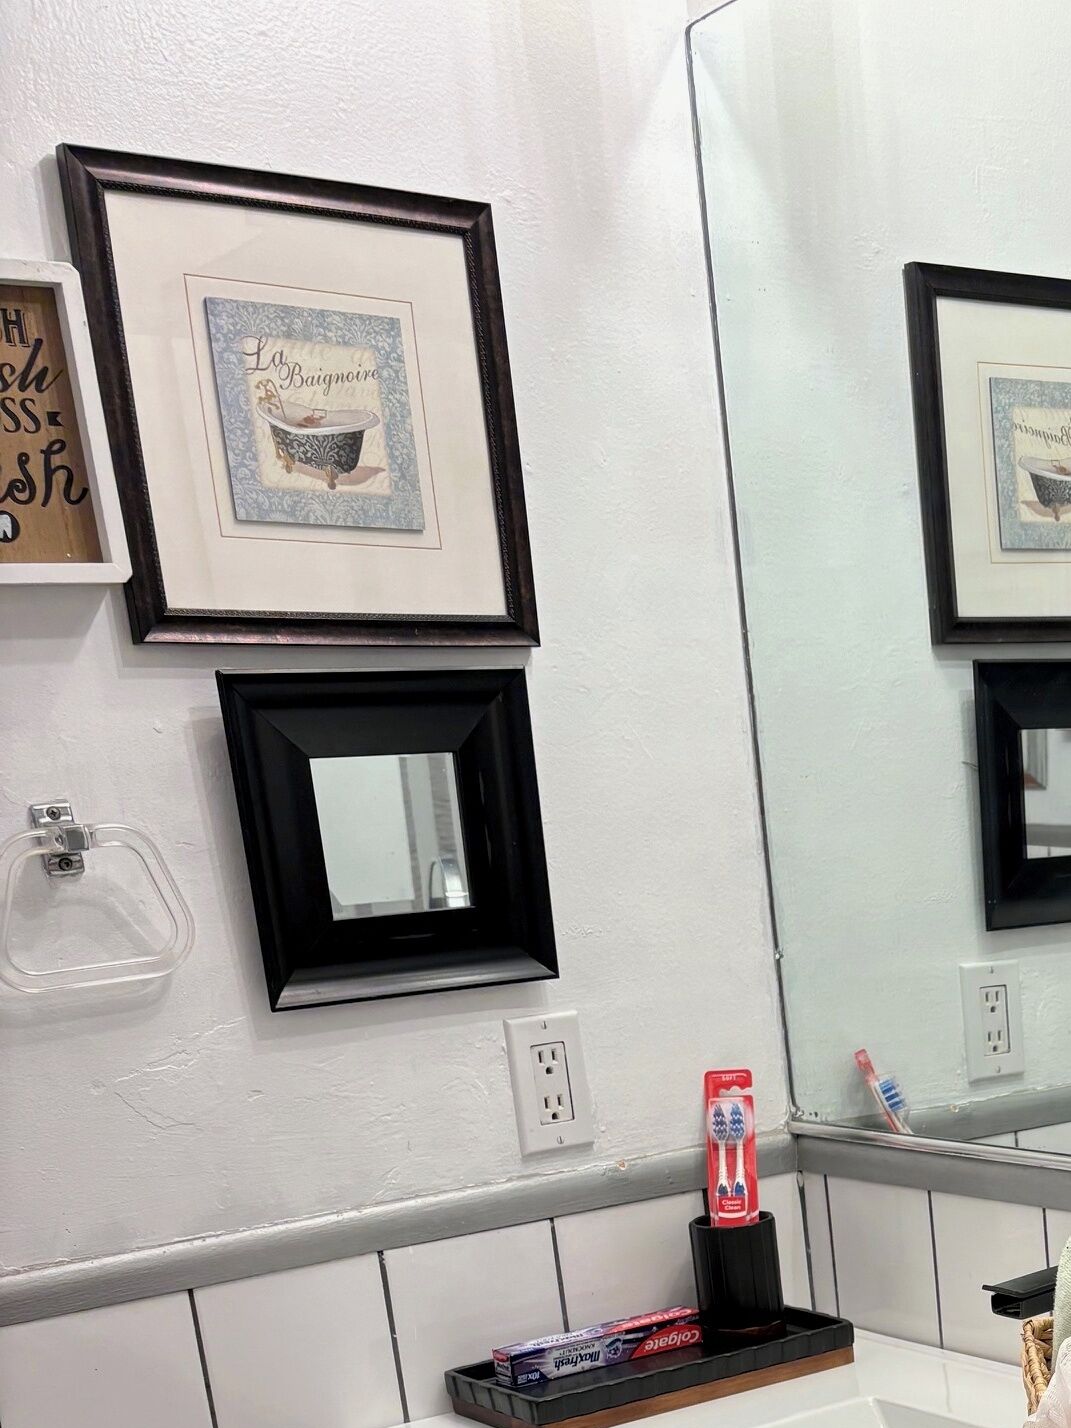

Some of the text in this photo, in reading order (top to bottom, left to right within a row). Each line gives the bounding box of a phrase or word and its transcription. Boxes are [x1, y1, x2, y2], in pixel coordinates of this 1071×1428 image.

[240, 335, 287, 375] La
[278, 362, 380, 396] Baignoire
[645, 1330, 700, 1351] Colgate
